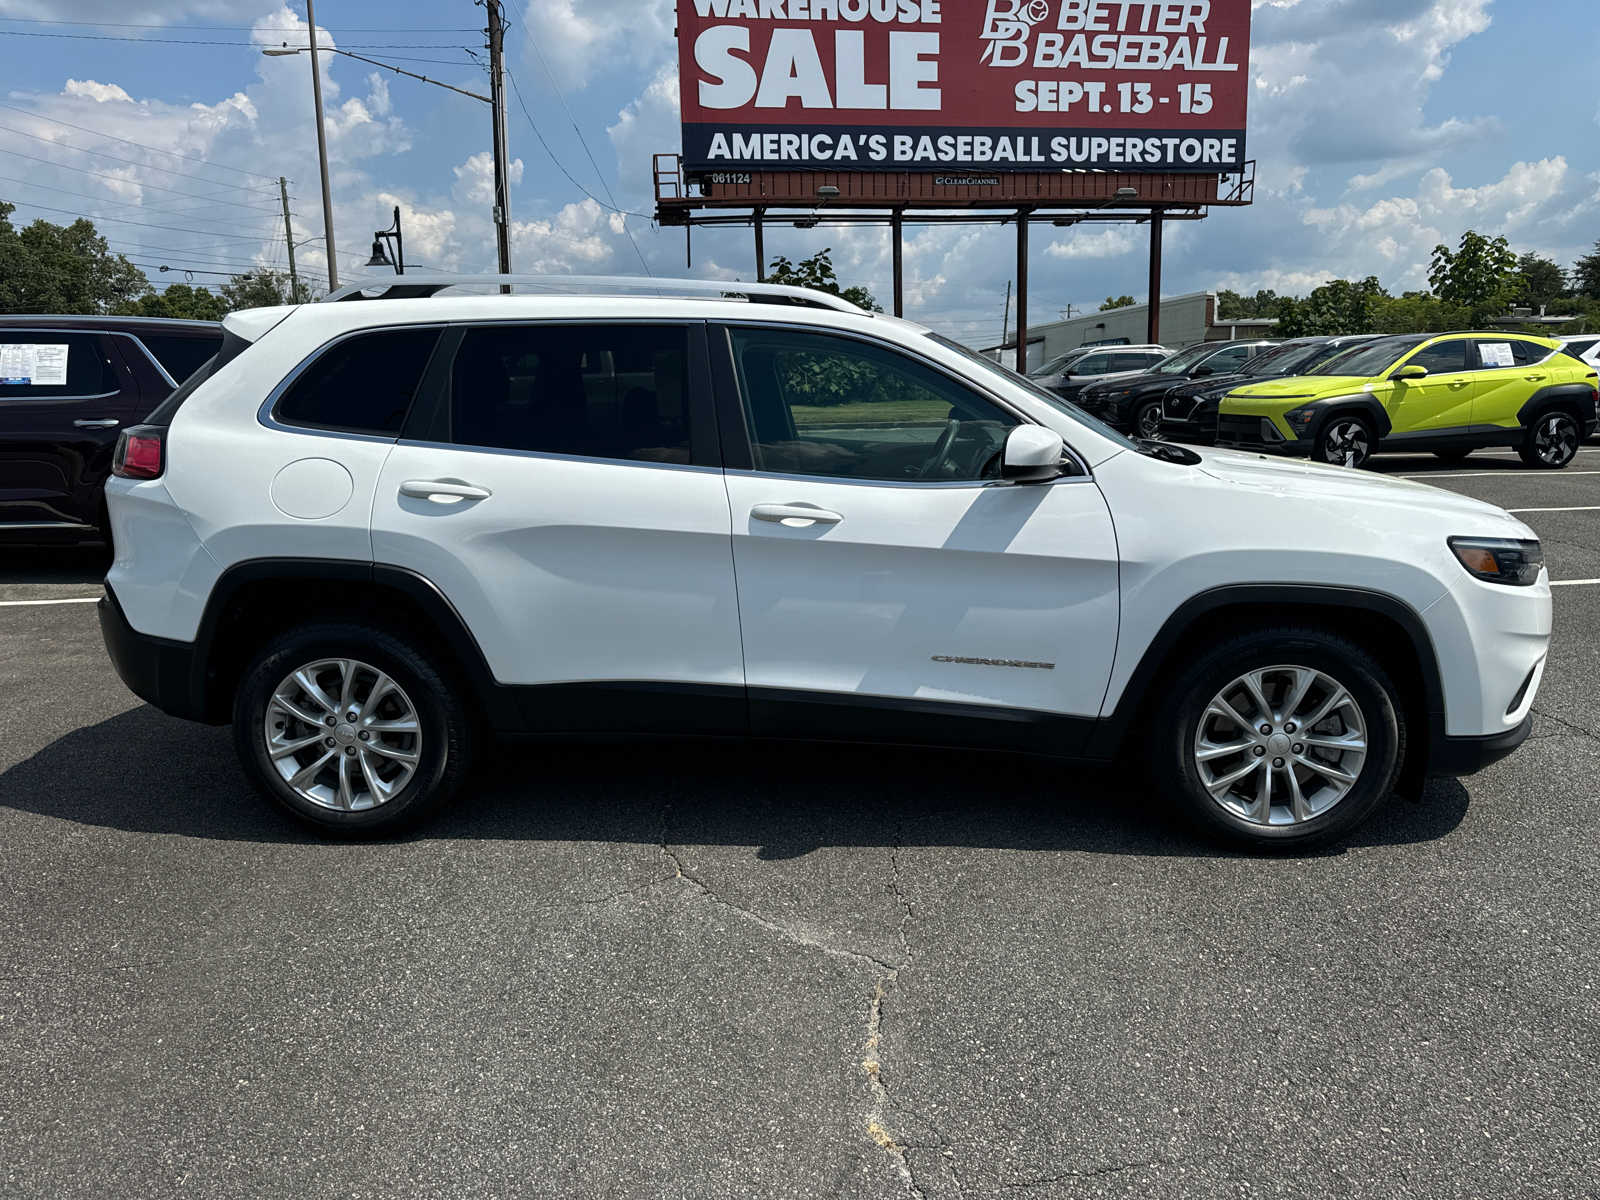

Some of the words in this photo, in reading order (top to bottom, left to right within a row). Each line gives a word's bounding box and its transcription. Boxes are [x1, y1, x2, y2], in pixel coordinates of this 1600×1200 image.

[1056, 0, 1211, 33] BETTER
[694, 24, 942, 110] SALE
[1032, 33, 1239, 71] BASEBALL
[1014, 79, 1112, 114] SEPT.
[1117, 81, 1154, 114] 13
[1177, 82, 1213, 115] 15
[706, 132, 888, 161] AMERICA'S
[893, 135, 1046, 162] BASEBALL
[1050, 136, 1237, 163] SUPERSTORE
[930, 655, 1055, 670] CHEROKEE
